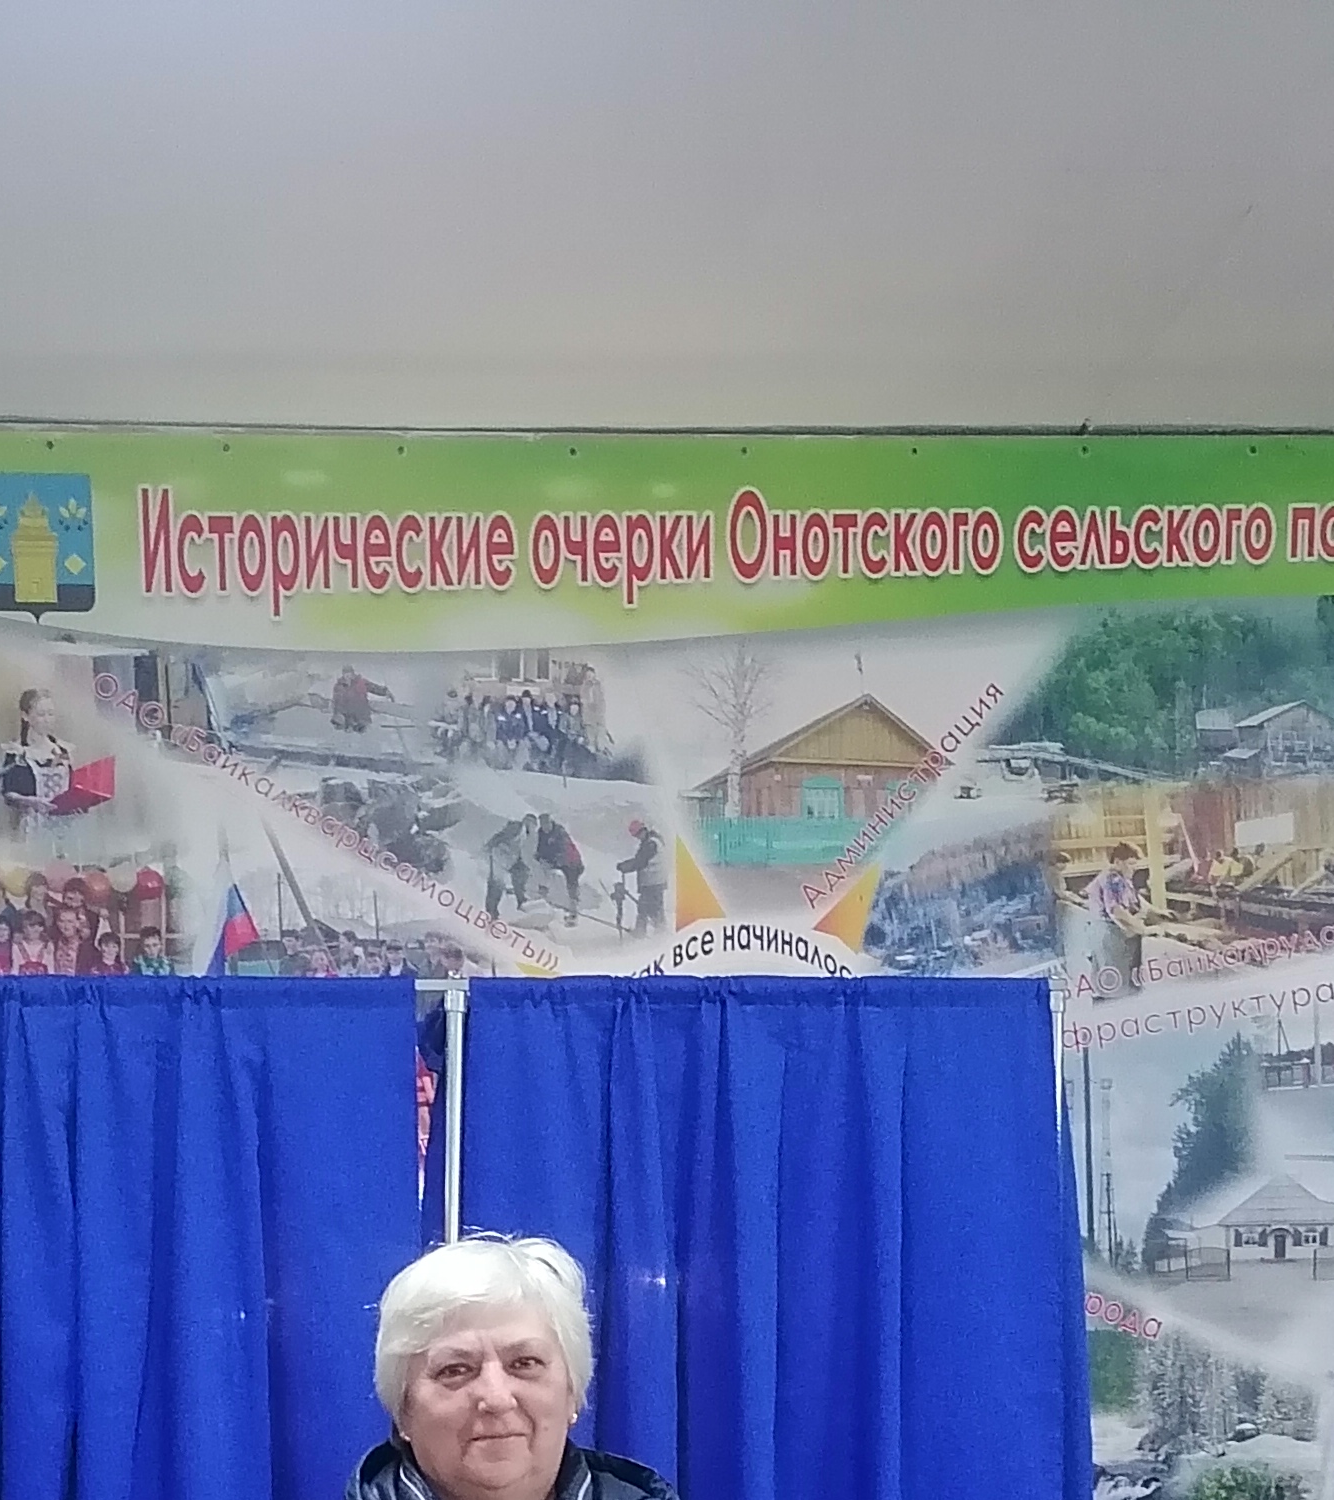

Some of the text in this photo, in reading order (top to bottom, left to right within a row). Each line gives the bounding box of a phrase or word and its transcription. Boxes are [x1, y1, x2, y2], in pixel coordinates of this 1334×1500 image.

[140, 486, 516, 618] Исторические
[531, 511, 713, 606] очерки
[730, 487, 1001, 582] Онотского
[1017, 506, 1273, 571] сельского
[94, 674, 165, 728] ОАО
[803, 683, 1004, 909] Администрация
[672, 929, 715, 968] все
